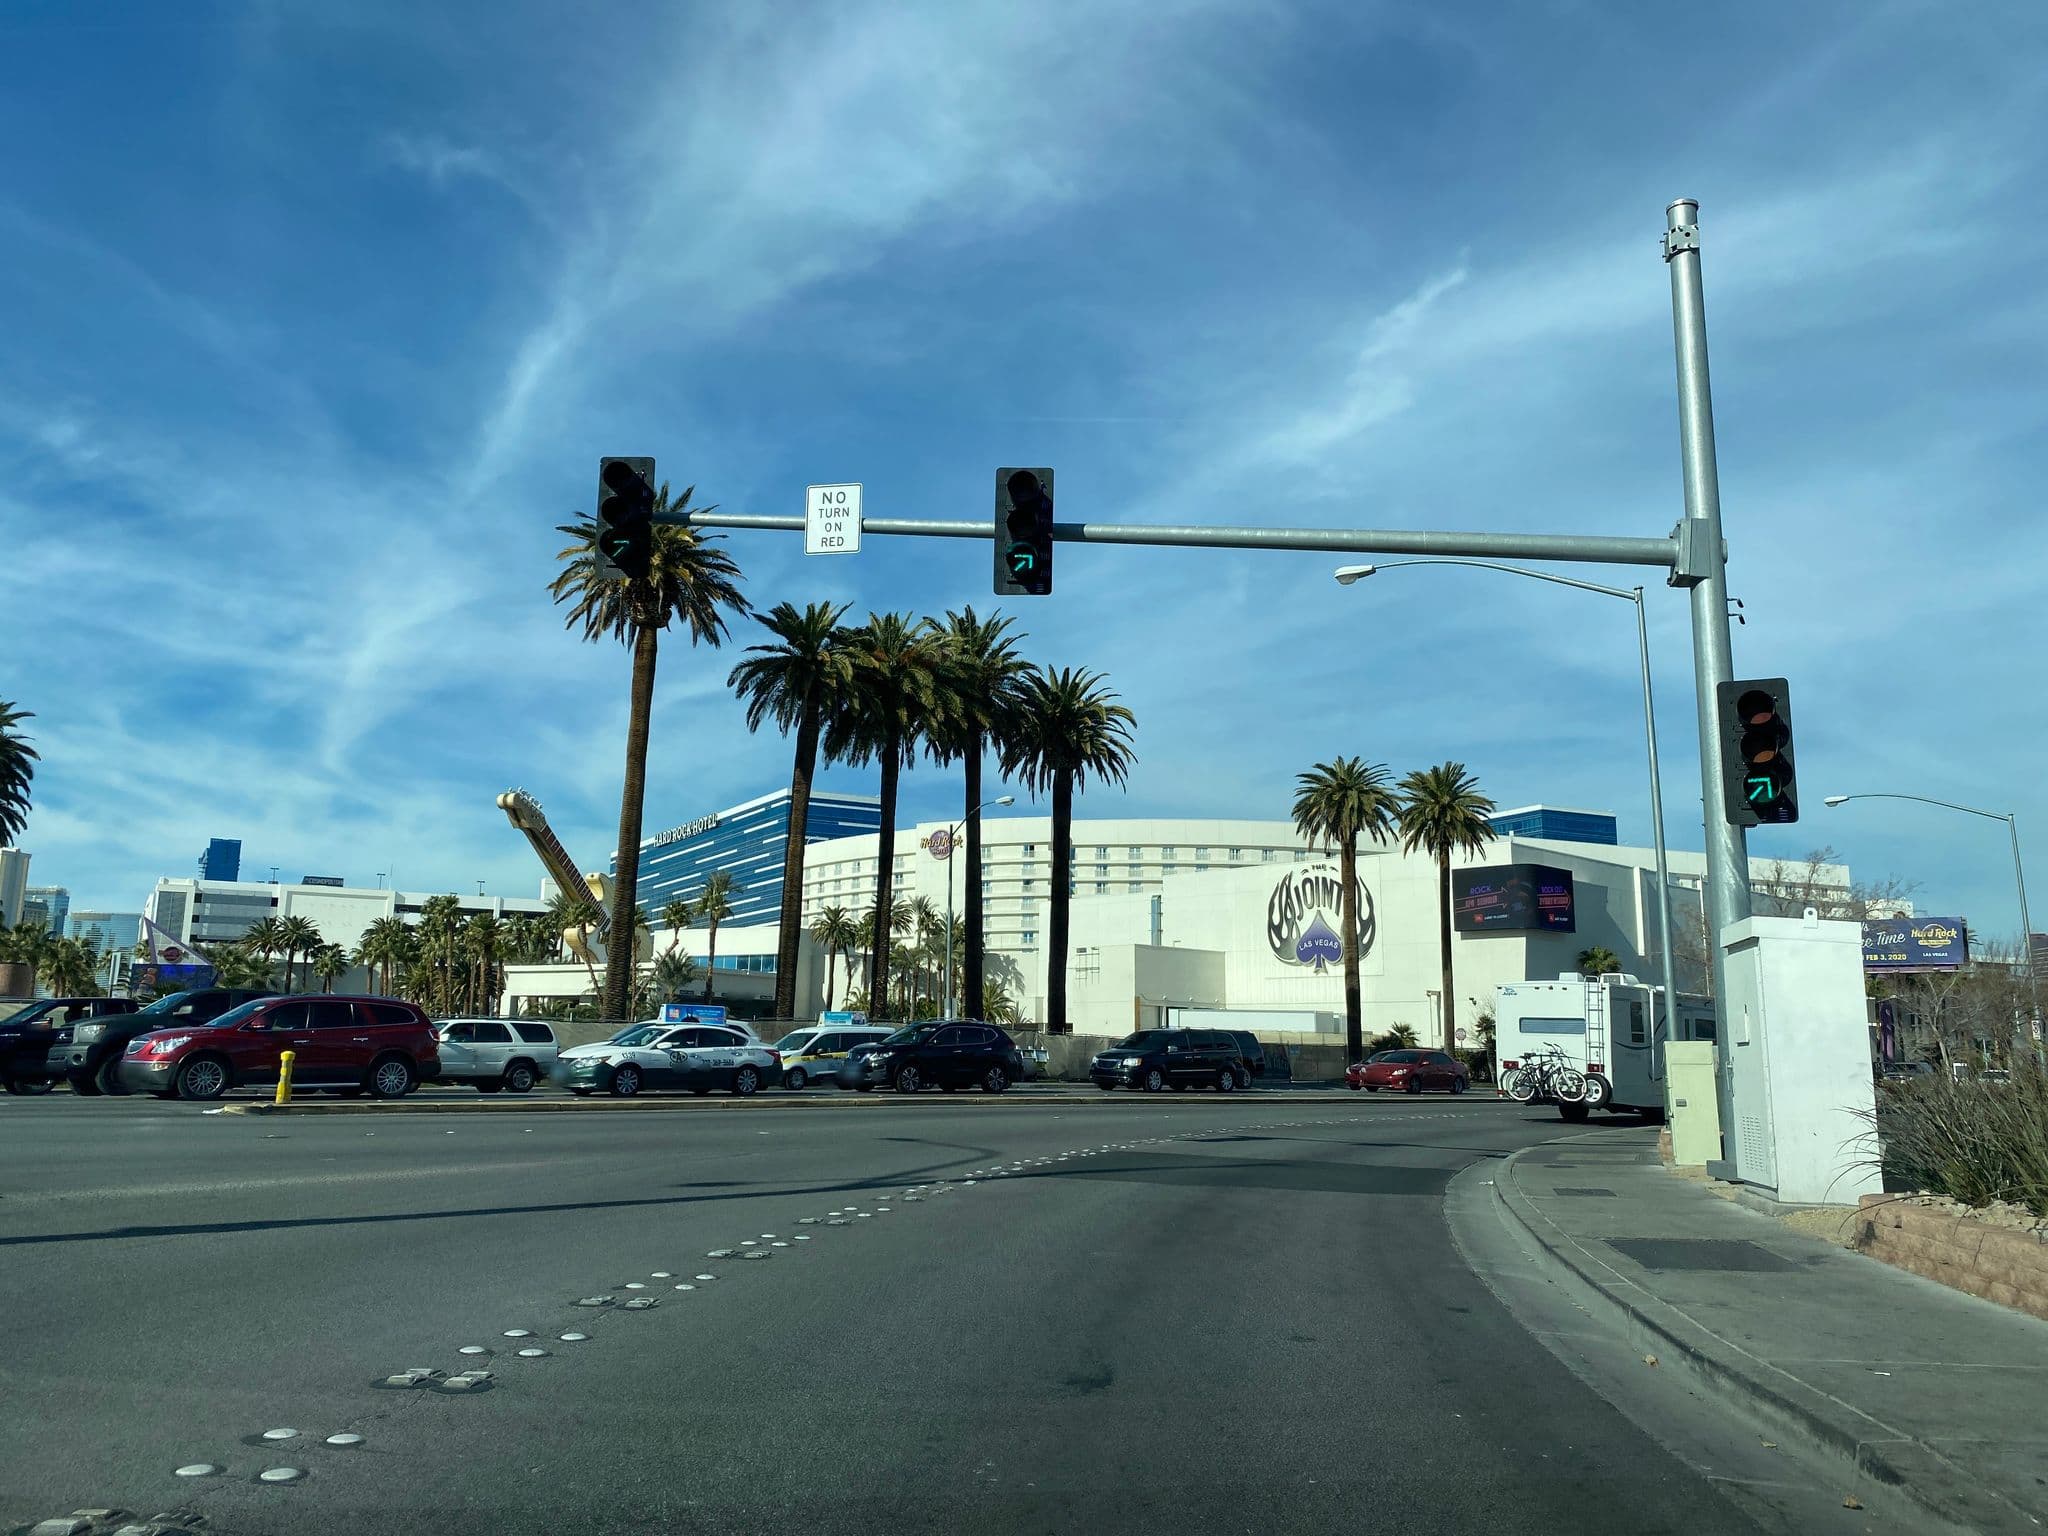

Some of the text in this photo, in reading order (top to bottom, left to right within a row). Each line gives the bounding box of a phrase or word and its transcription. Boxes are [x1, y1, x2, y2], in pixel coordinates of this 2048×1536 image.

[822, 491, 846, 504] NO
[818, 507, 850, 518] TURN
[825, 522, 842, 532] ON
[821, 536, 844, 547] RED
[653, 812, 718, 848] HARD ROCK HOTEL
[1312, 863, 1327, 872] THE
[1293, 875, 1344, 921] JOINT
[1876, 931, 1906, 946] Time
[1911, 927, 1958, 939] Hard Rock
[1299, 938, 1339, 951] LAS VEGAS
[1888, 953, 1907, 961] 2020
